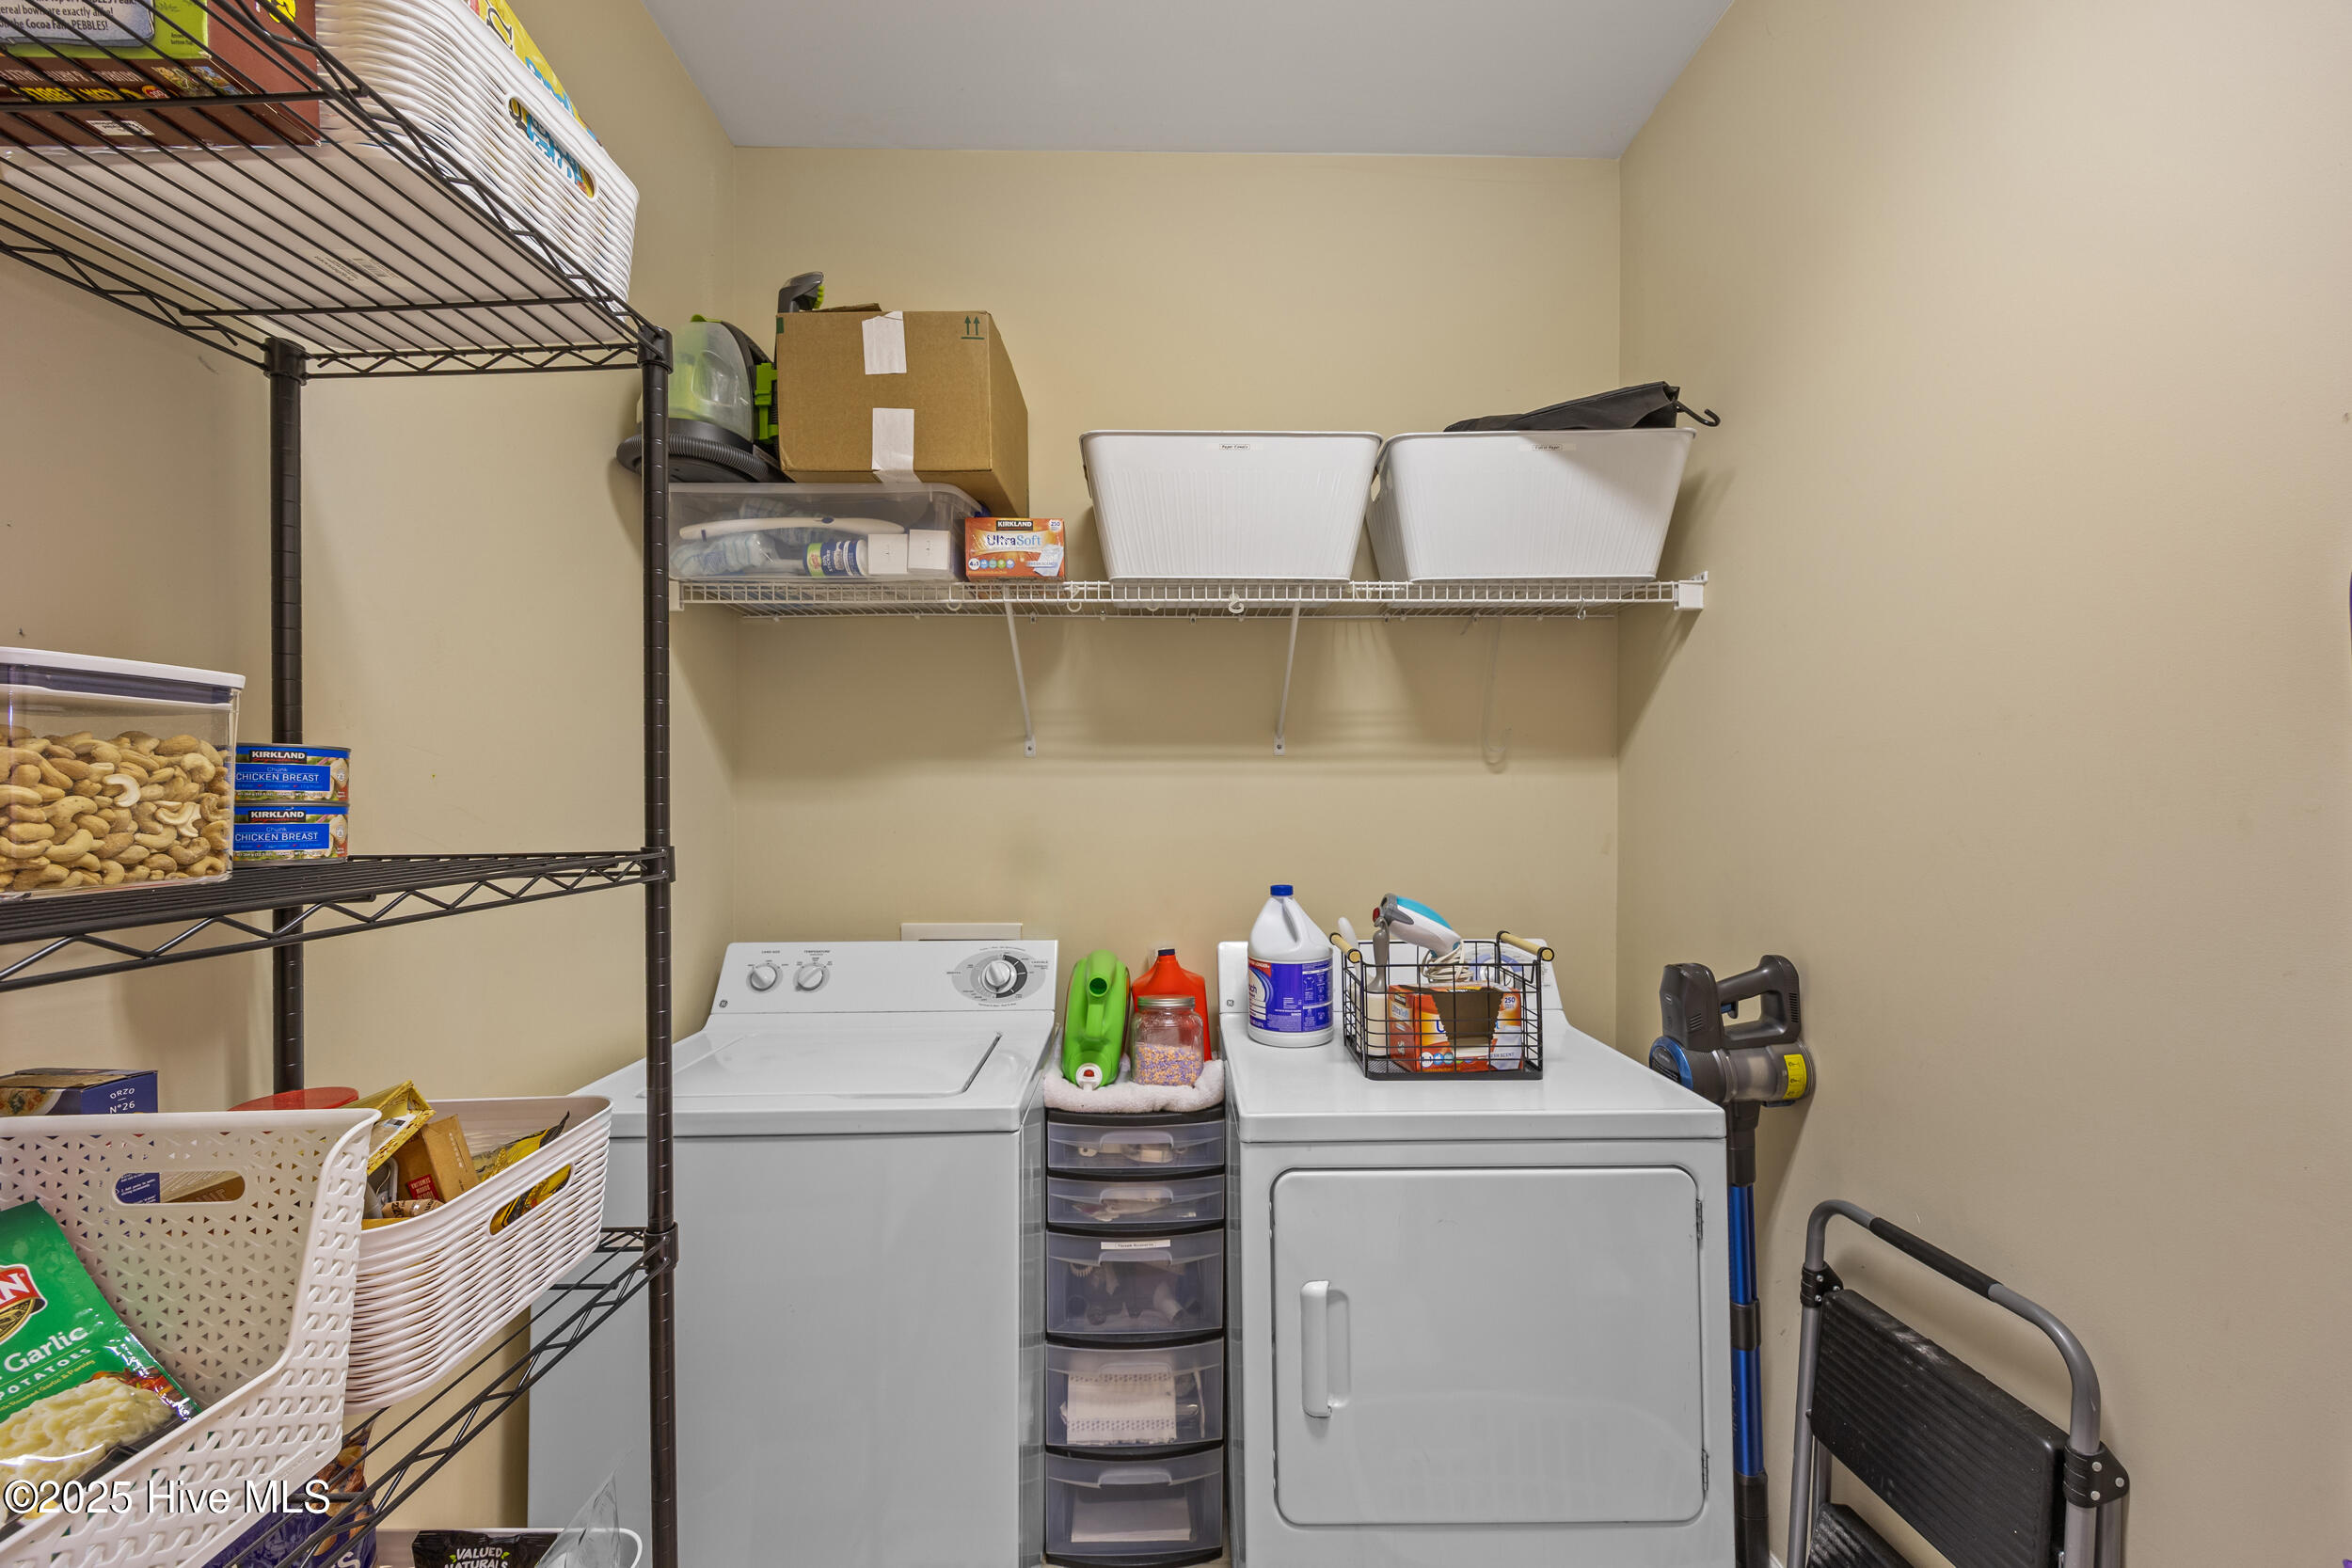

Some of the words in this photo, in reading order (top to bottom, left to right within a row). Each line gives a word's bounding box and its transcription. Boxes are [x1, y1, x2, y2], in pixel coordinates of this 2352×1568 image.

[0, 4, 21, 14] ereal
[62, 7, 90, 18] exactly
[26, 19, 51, 29] Cocoa
[72, 19, 108, 31] PEBBLES!
[251, 751, 306, 759] KIRKLAND
[282, 773, 320, 782] BREAST
[234, 833, 278, 842] CHICKEN
[281, 832, 318, 841] BREAST
[109, 1087, 135, 1101] ORZO
[4, 1326, 88, 1372] Garlic
[456, 1546, 503, 1560] VALUED
